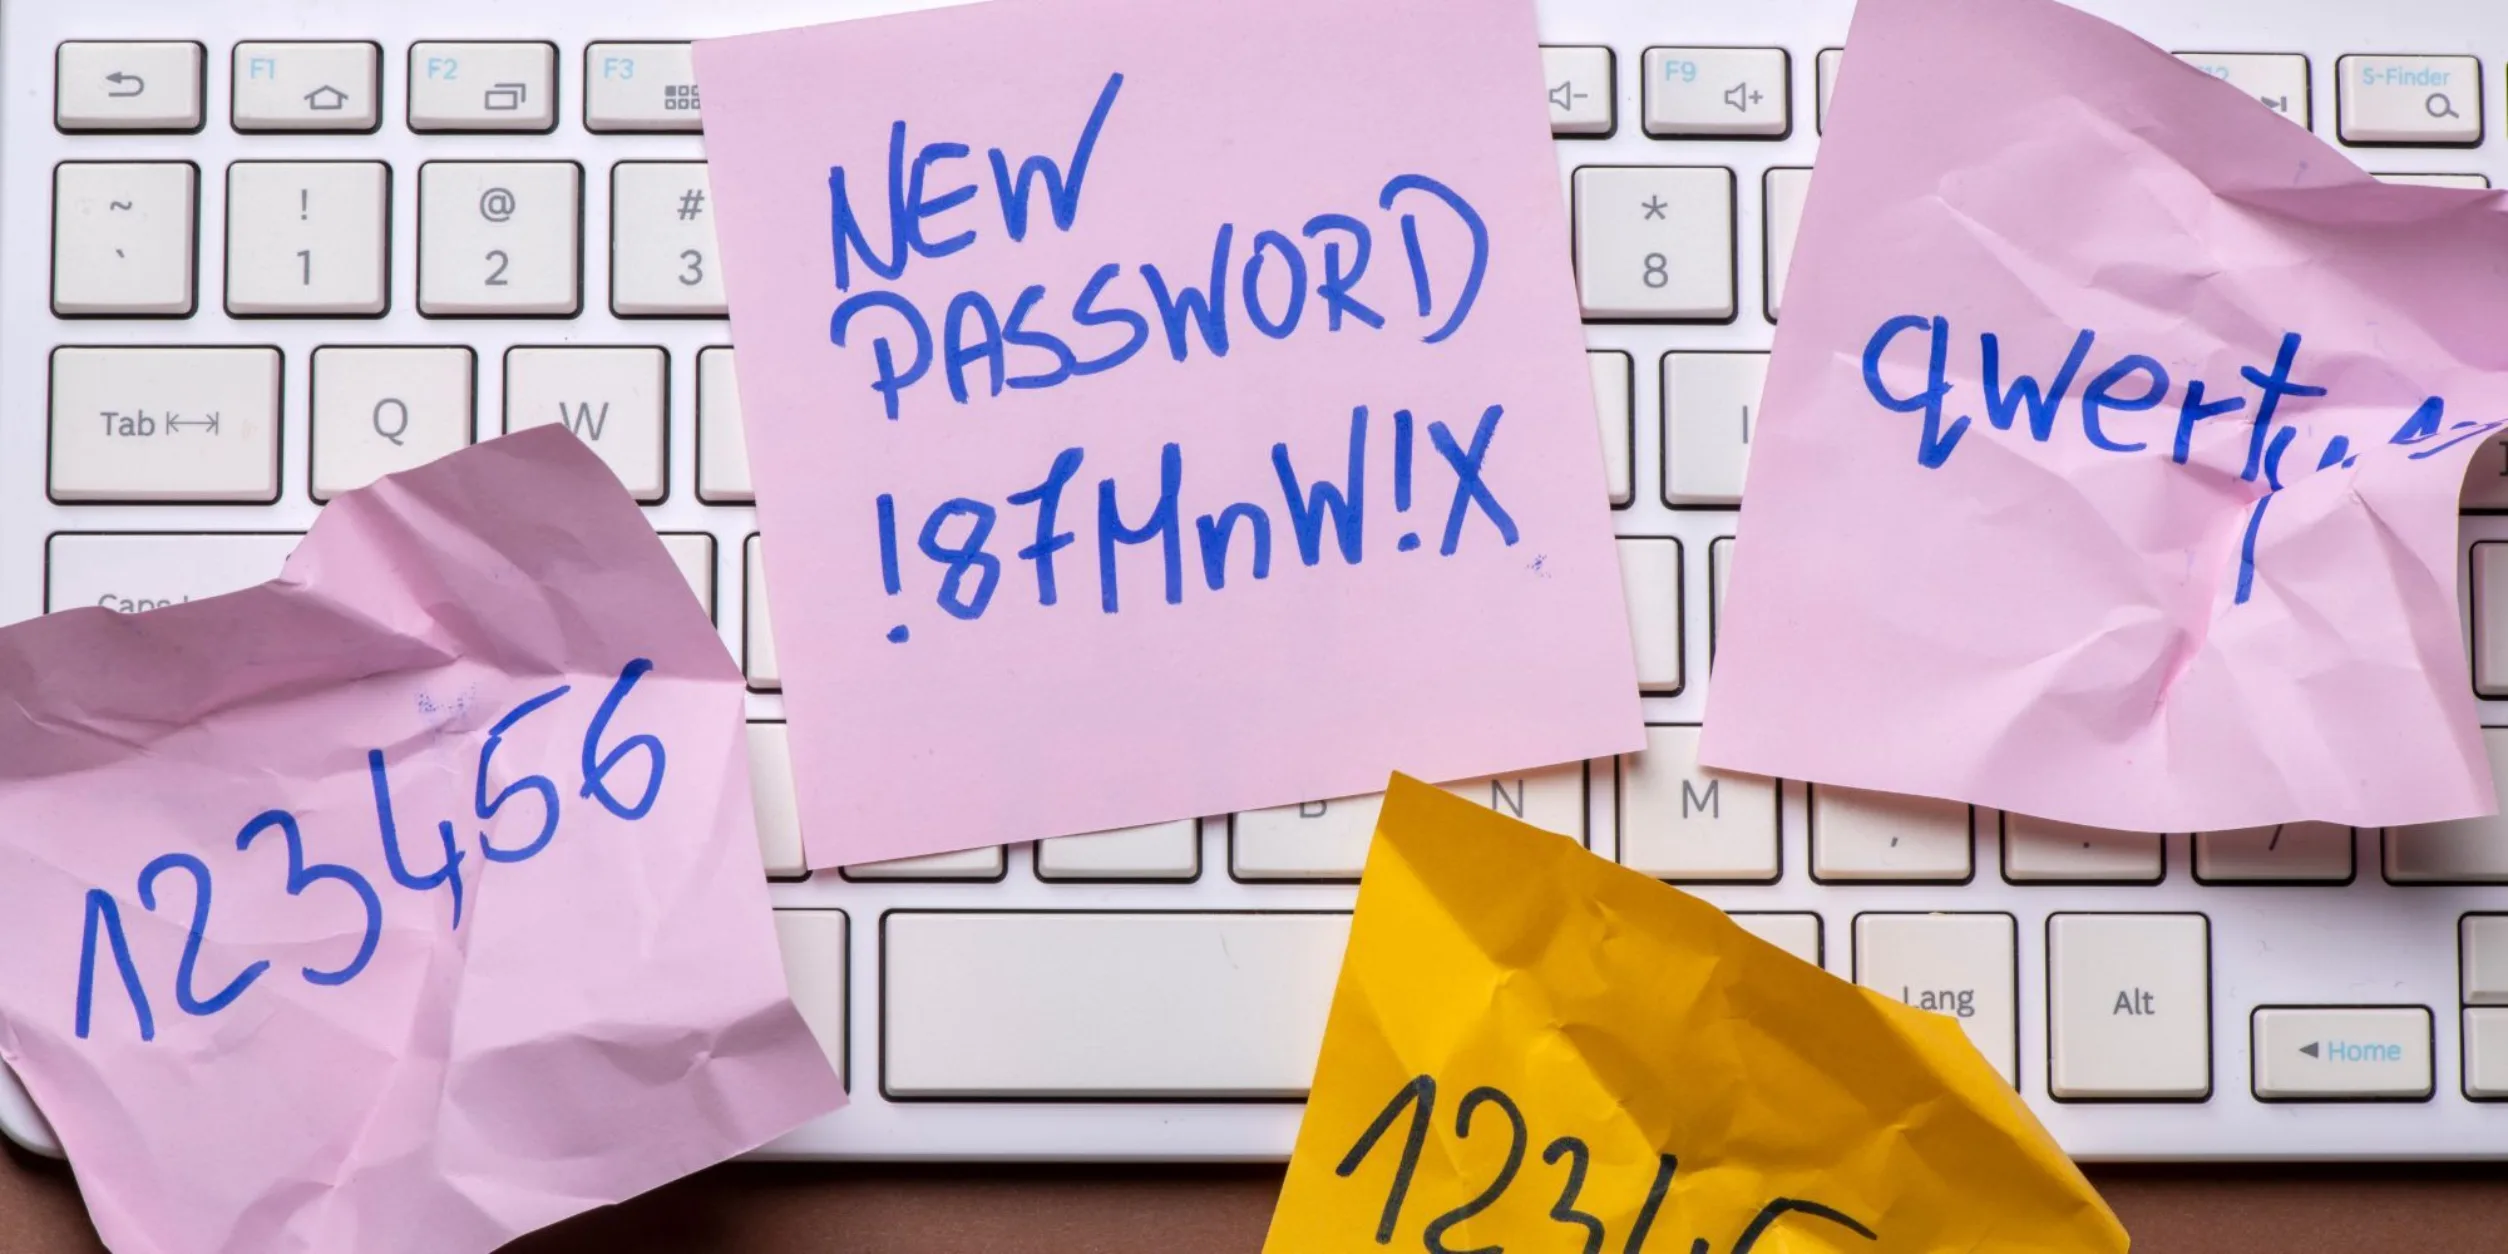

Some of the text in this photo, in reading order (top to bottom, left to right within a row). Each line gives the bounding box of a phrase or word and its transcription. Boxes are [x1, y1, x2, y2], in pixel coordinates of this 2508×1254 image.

[250, 58, 276, 79] F1
[427, 58, 459, 80] F2
[603, 58, 635, 80] F3
[1664, 60, 1697, 83] F9
[2362, 66, 2452, 86] S-Finder
[829, 72, 1123, 292] NEW
[479, 187, 516, 223] @
[677, 188, 705, 221] #
[296, 249, 311, 286] 1
[484, 249, 509, 286] 2
[678, 249, 704, 286] 3
[1643, 252, 1669, 289] 8
[830, 173, 1490, 420] PASSWORD
[100, 409, 156, 438] Tab
[372, 397, 409, 447] Q
[558, 401, 609, 442] W
[876, 404, 1519, 643] !87MnW!X
[1490, 779, 1525, 819] N
[1681, 779, 1720, 819] M
[75, 658, 667, 1041] 123456
[1903, 985, 1976, 1018] Lang
[2112, 987, 2156, 1017] Alt
[2327, 1040, 2402, 1063] Home
